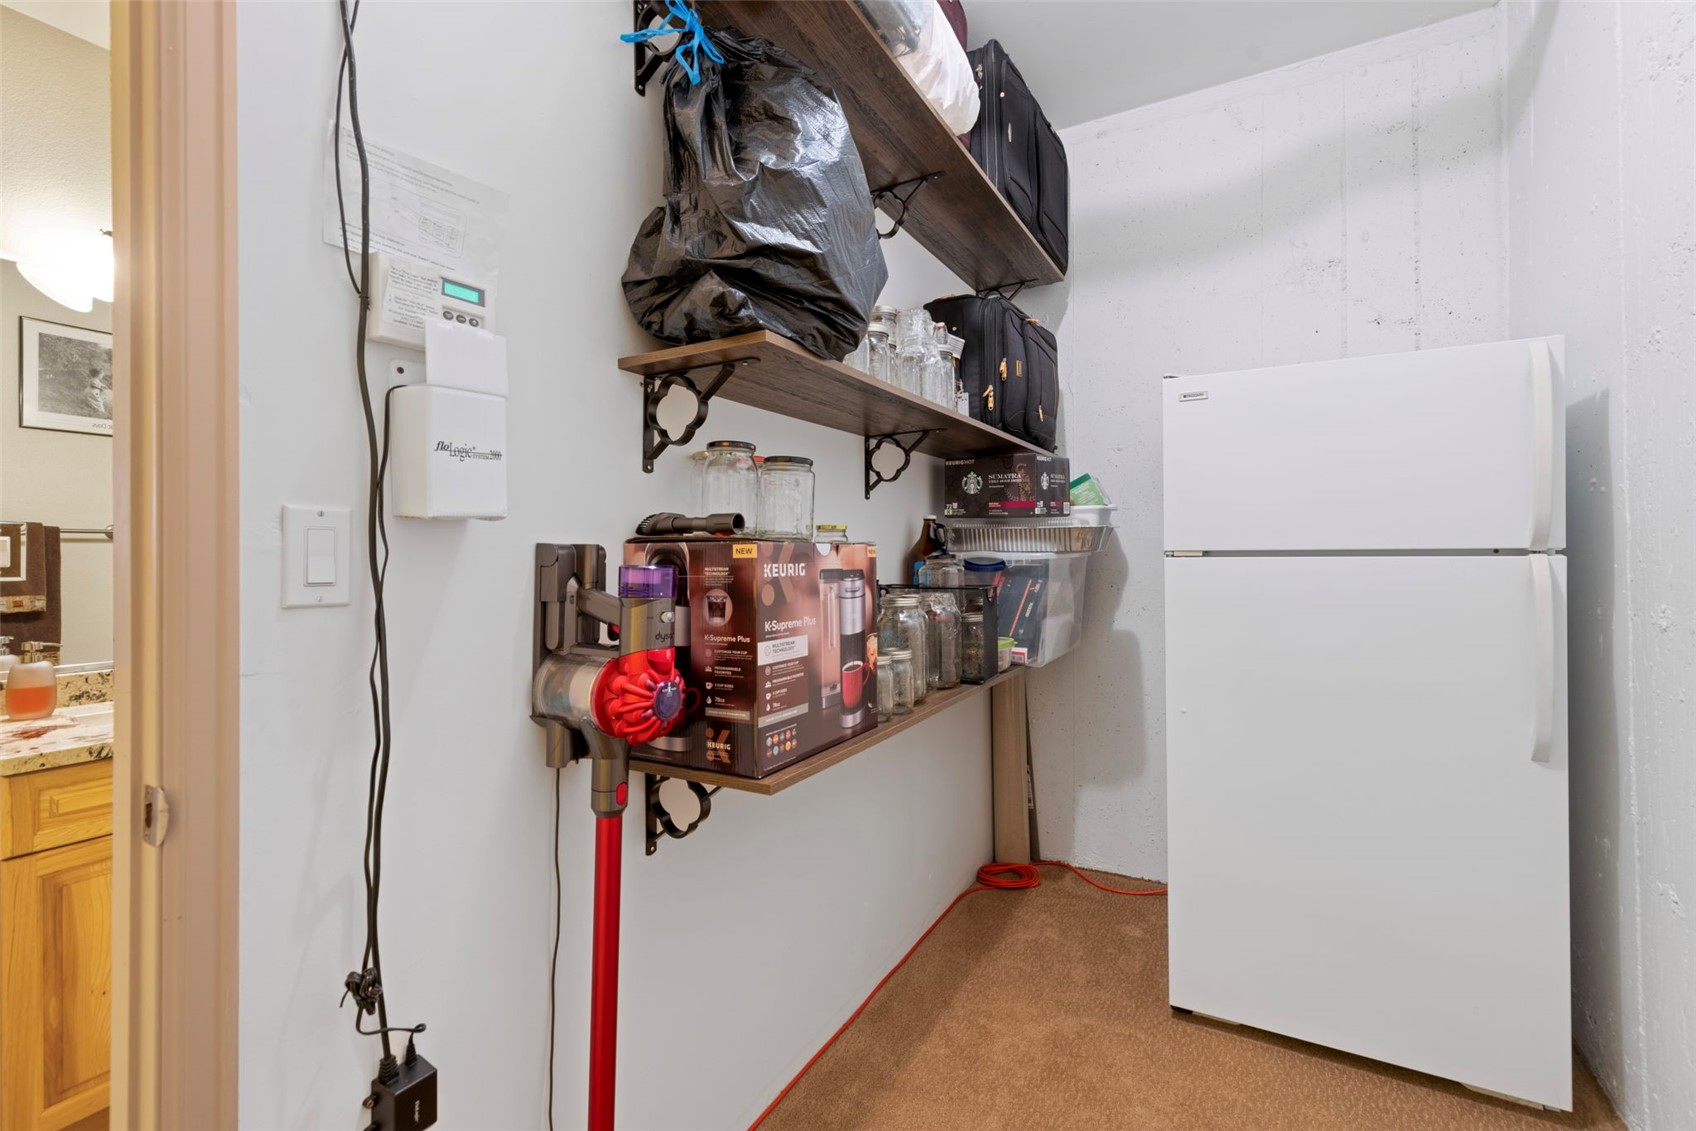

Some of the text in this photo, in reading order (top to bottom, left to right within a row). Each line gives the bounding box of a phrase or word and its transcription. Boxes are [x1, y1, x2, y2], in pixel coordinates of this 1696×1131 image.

[763, 562, 807, 578] KEURIG
[764, 616, 817, 633] K-Supreme Plus
[704, 634, 751, 643] K-Supreme Plus
[707, 741, 731, 750] KEURIG
